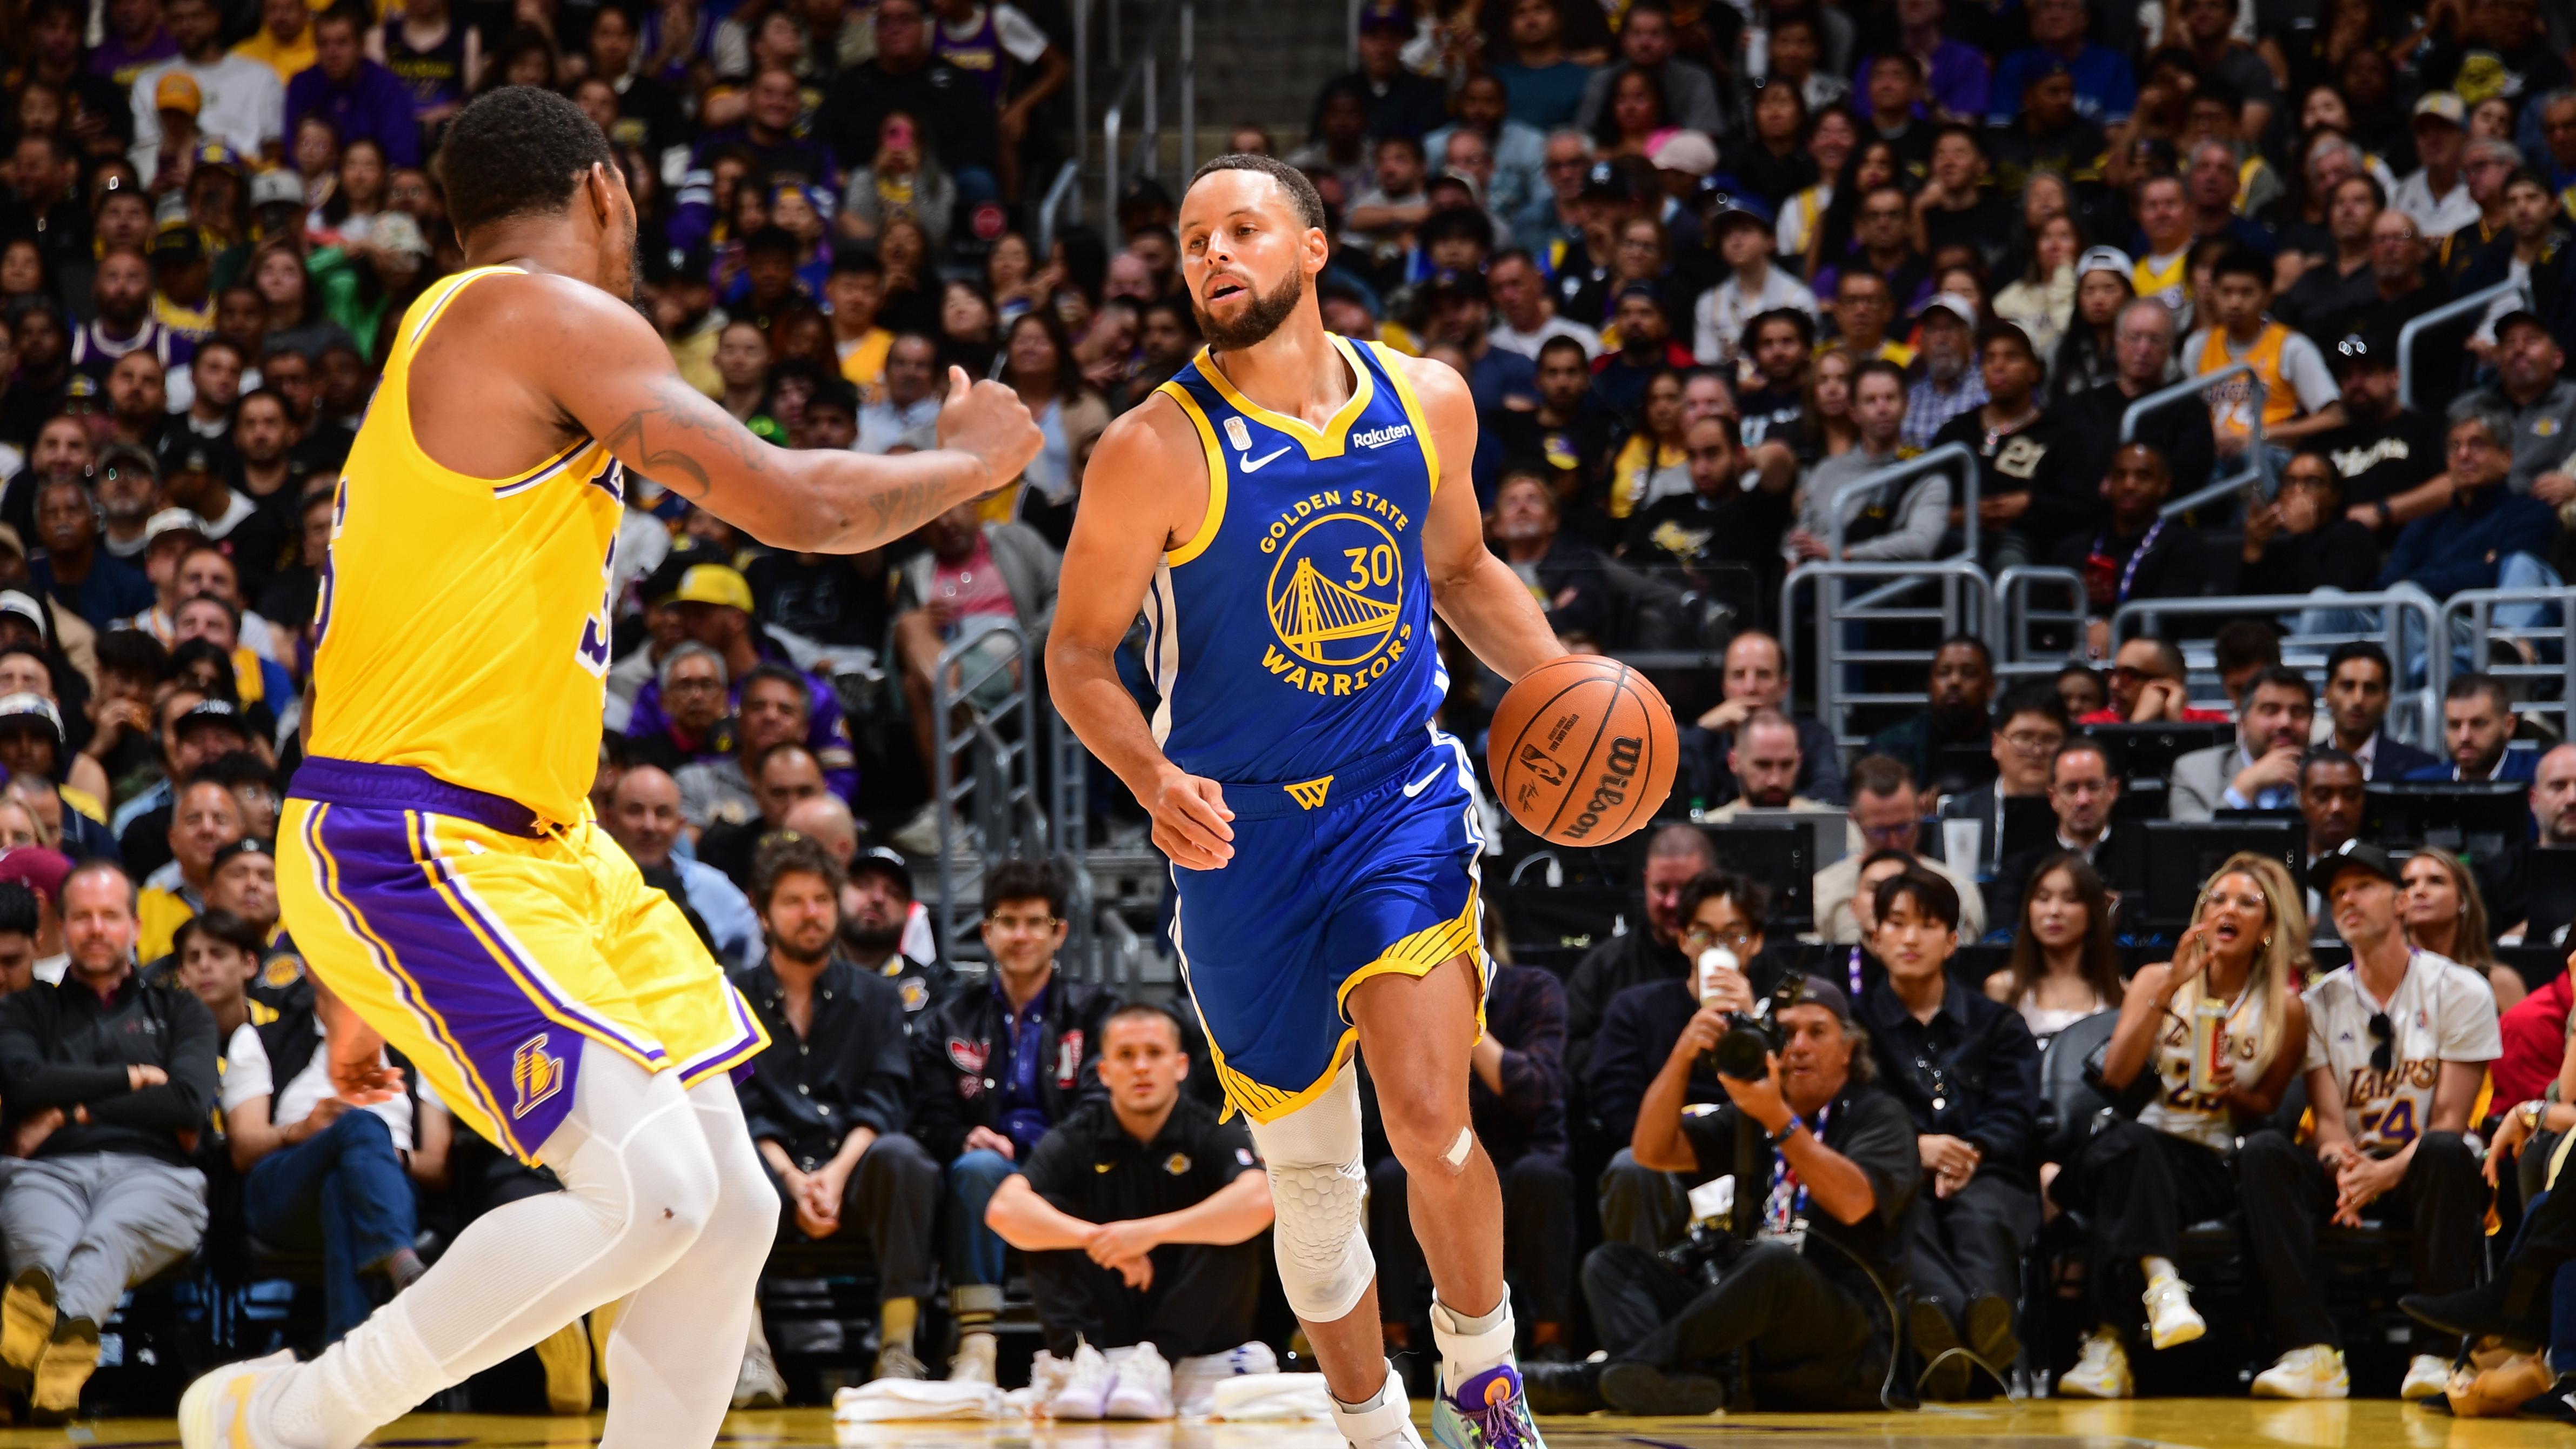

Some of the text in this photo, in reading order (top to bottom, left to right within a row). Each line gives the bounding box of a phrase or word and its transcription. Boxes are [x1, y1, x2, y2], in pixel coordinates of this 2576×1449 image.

[1352, 424, 1412, 449] Rakuten
[1260, 489, 1409, 554] GOLDEN STATE
[1343, 544, 1393, 592] 30
[1262, 622, 1411, 697] WARRIORS
[1561, 736, 1643, 839] Wilson
